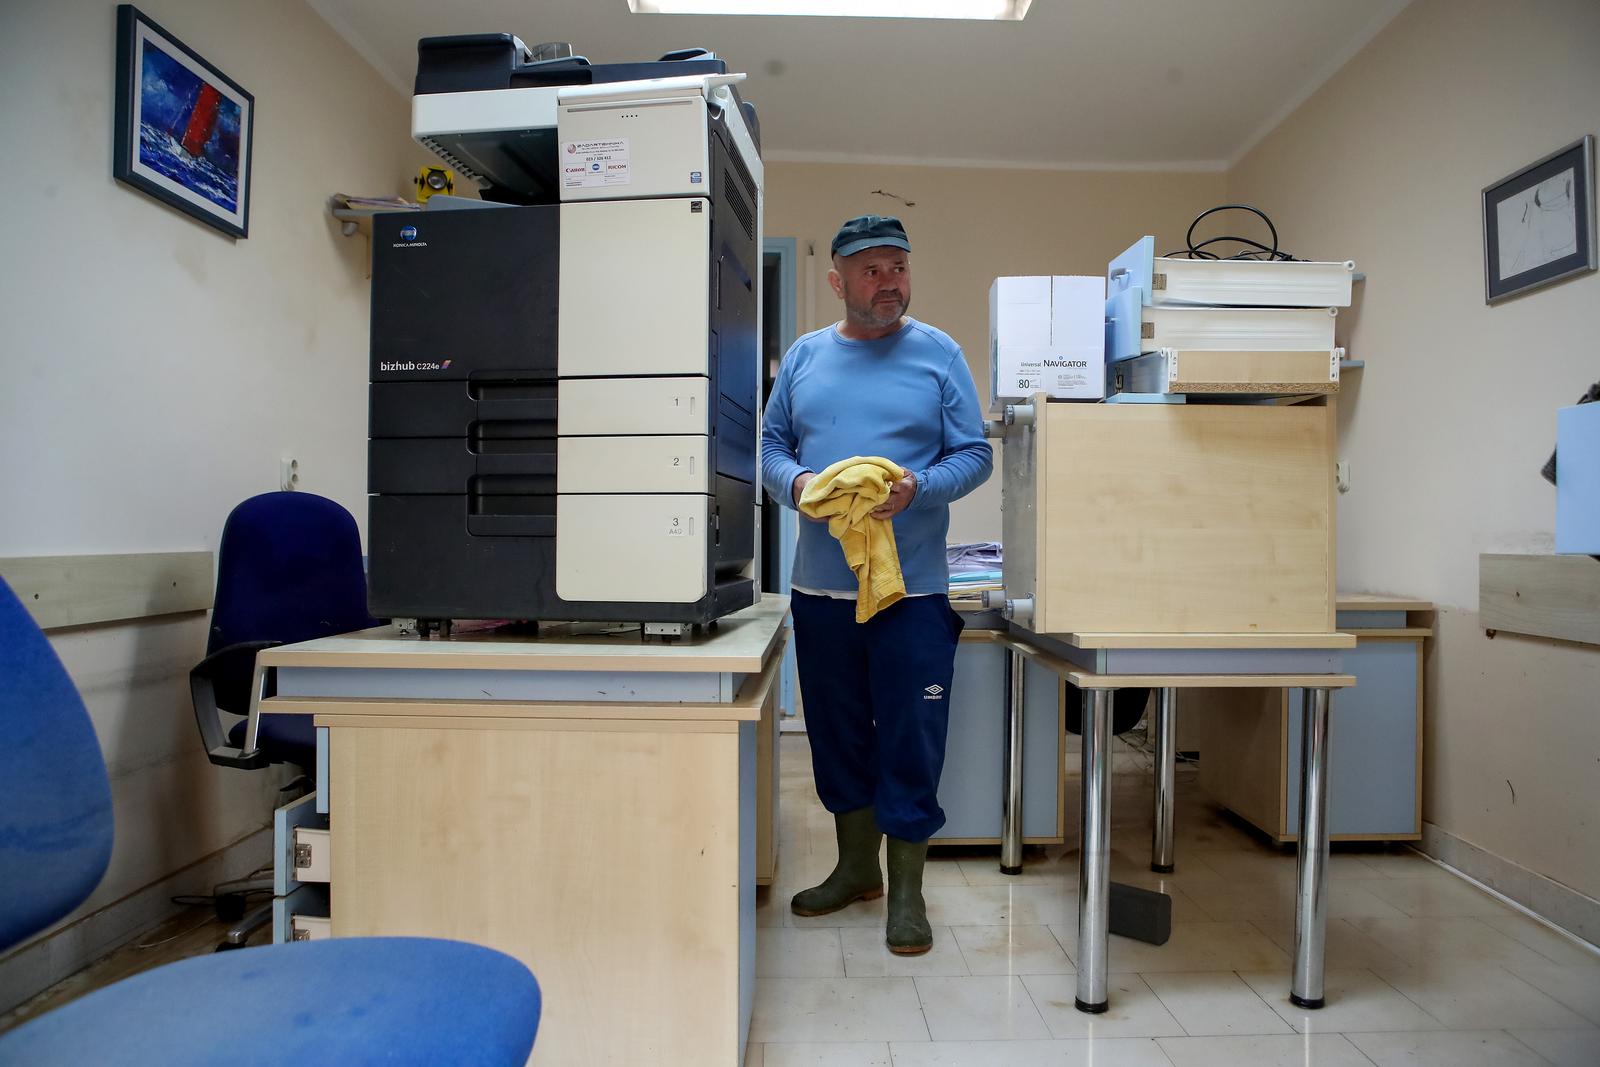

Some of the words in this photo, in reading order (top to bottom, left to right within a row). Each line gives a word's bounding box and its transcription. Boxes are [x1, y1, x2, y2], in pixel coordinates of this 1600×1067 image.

[380, 361, 415, 371] bizhub
[416, 362, 440, 370] C224e
[1018, 379, 1030, 389] 80
[674, 398, 679, 406] 1
[673, 458, 680, 466] 2
[672, 517, 679, 527] 3
